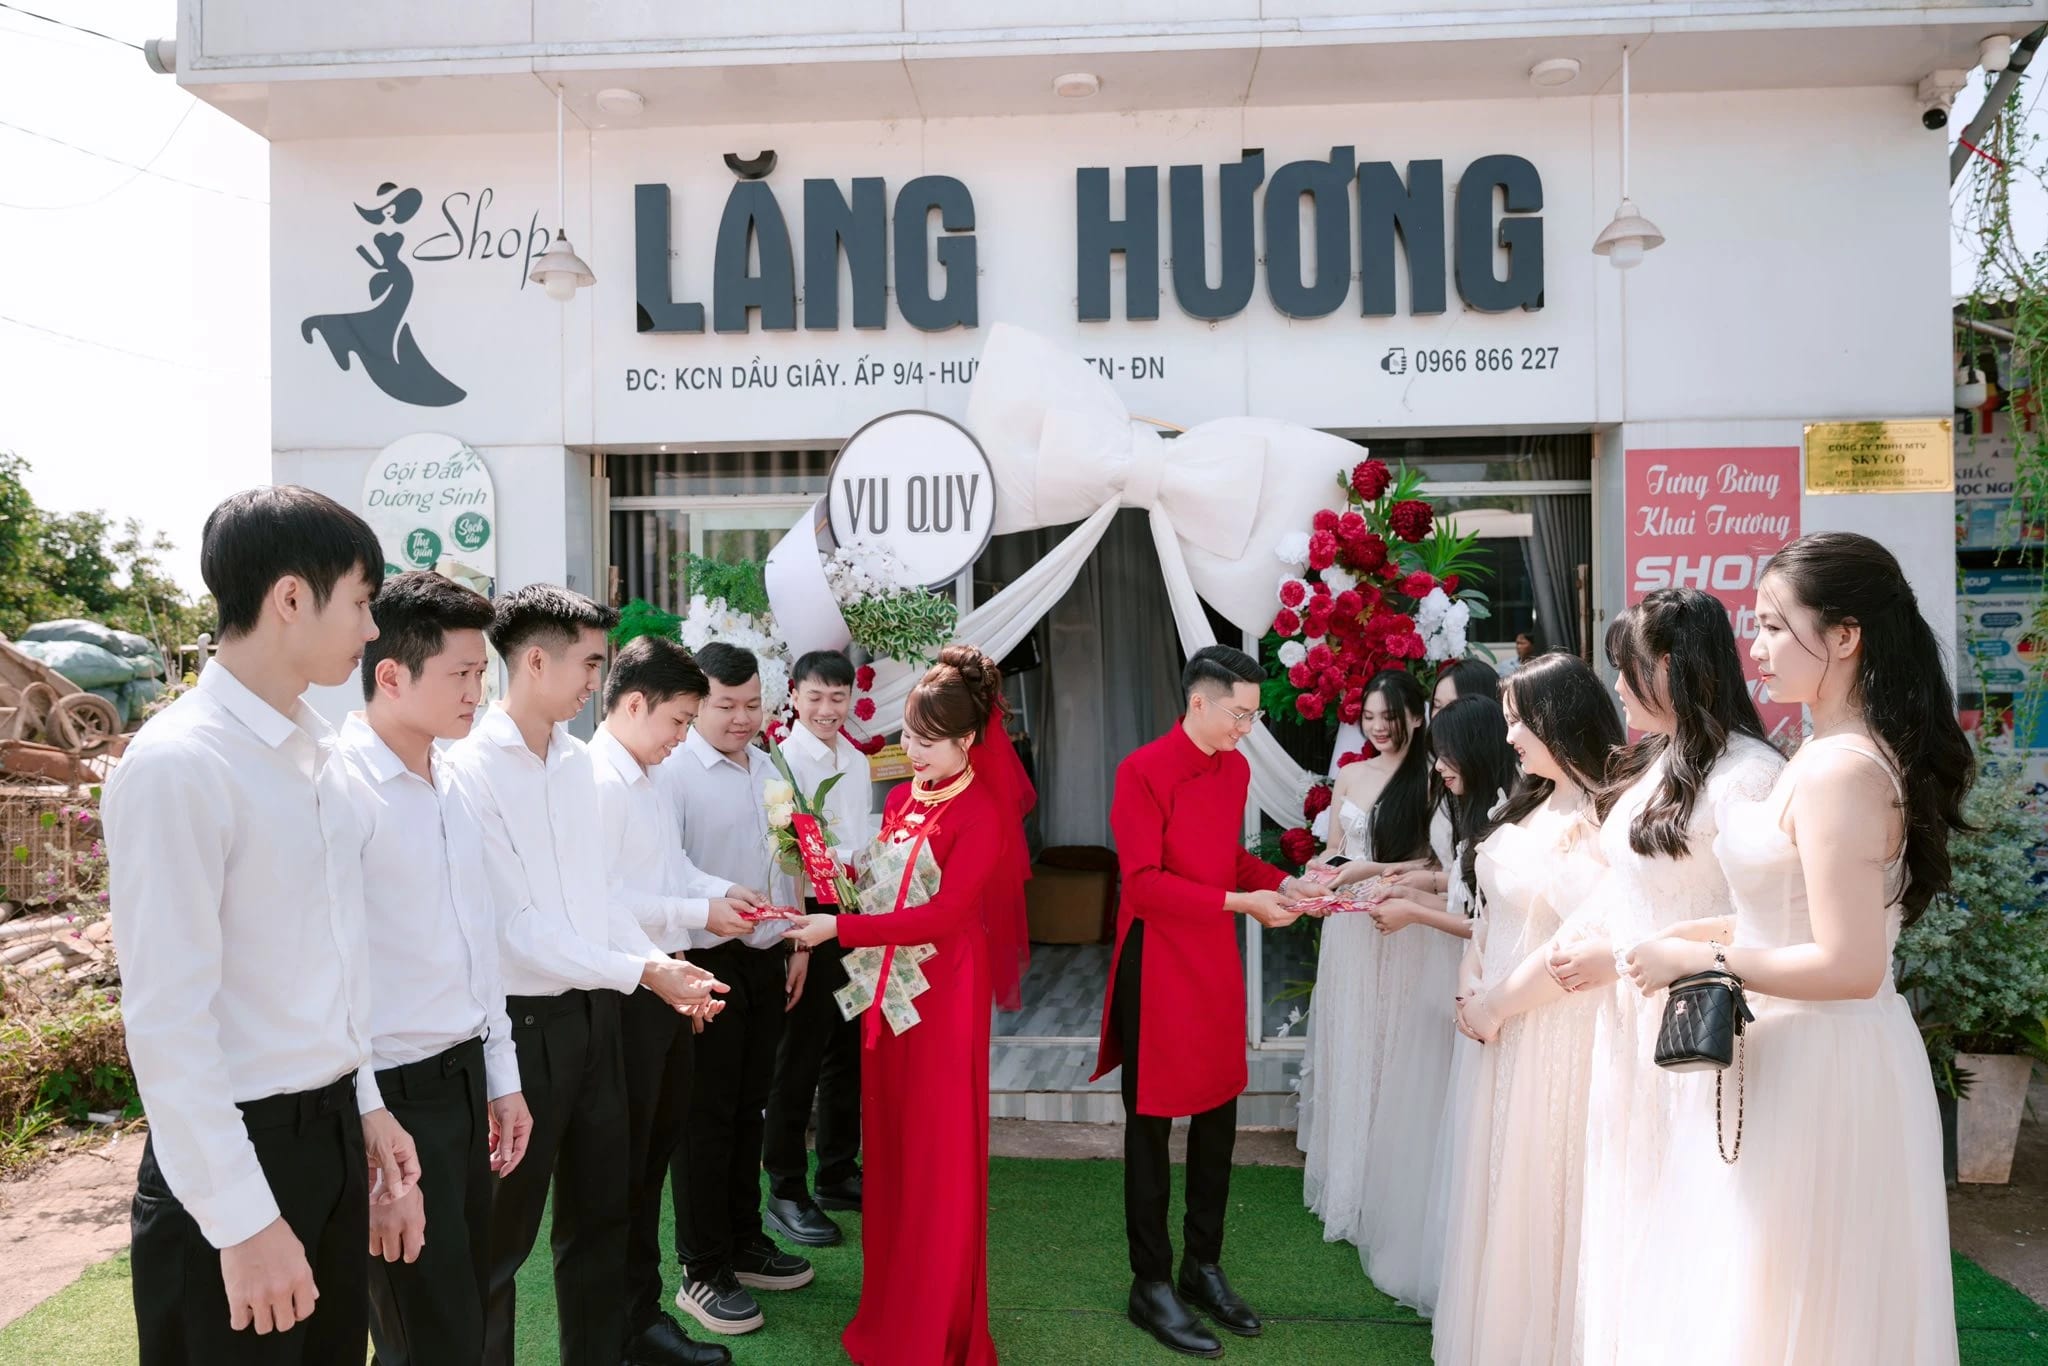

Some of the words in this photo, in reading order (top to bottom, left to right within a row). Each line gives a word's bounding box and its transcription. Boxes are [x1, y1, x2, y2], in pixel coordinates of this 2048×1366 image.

[412, 187, 551, 291] Shop
[634, 150, 979, 334] LĂNG
[1076, 145, 1544, 322] HƯƠNG
[626, 368, 665, 391] ĐC:
[675, 366, 722, 390] KCN
[732, 355, 778, 388] DẦU
[786, 358, 846, 388] GIÂY.
[854, 354, 885, 386] ẤP
[1415, 349, 1467, 373] 0966
[1475, 348, 1513, 372] 866
[1521, 346, 1559, 370] 227
[1851, 453, 1880, 465] SKY
[1884, 453, 1906, 464] GO
[1861, 443, 1873, 451] TY
[1905, 442, 1927, 450] MTV
[383, 461, 418, 485] Gội
[1646, 464, 1710, 500] Tưng
[1716, 463, 1780, 499] Bừng
[368, 488, 434, 513] Dưỡng
[439, 487, 487, 506] Sinh
[843, 476, 889, 535] VU
[907, 474, 979, 533] QUY
[458, 518, 484, 536] Sạch
[1634, 505, 1697, 536] Khai
[1705, 504, 1792, 540] Trương
